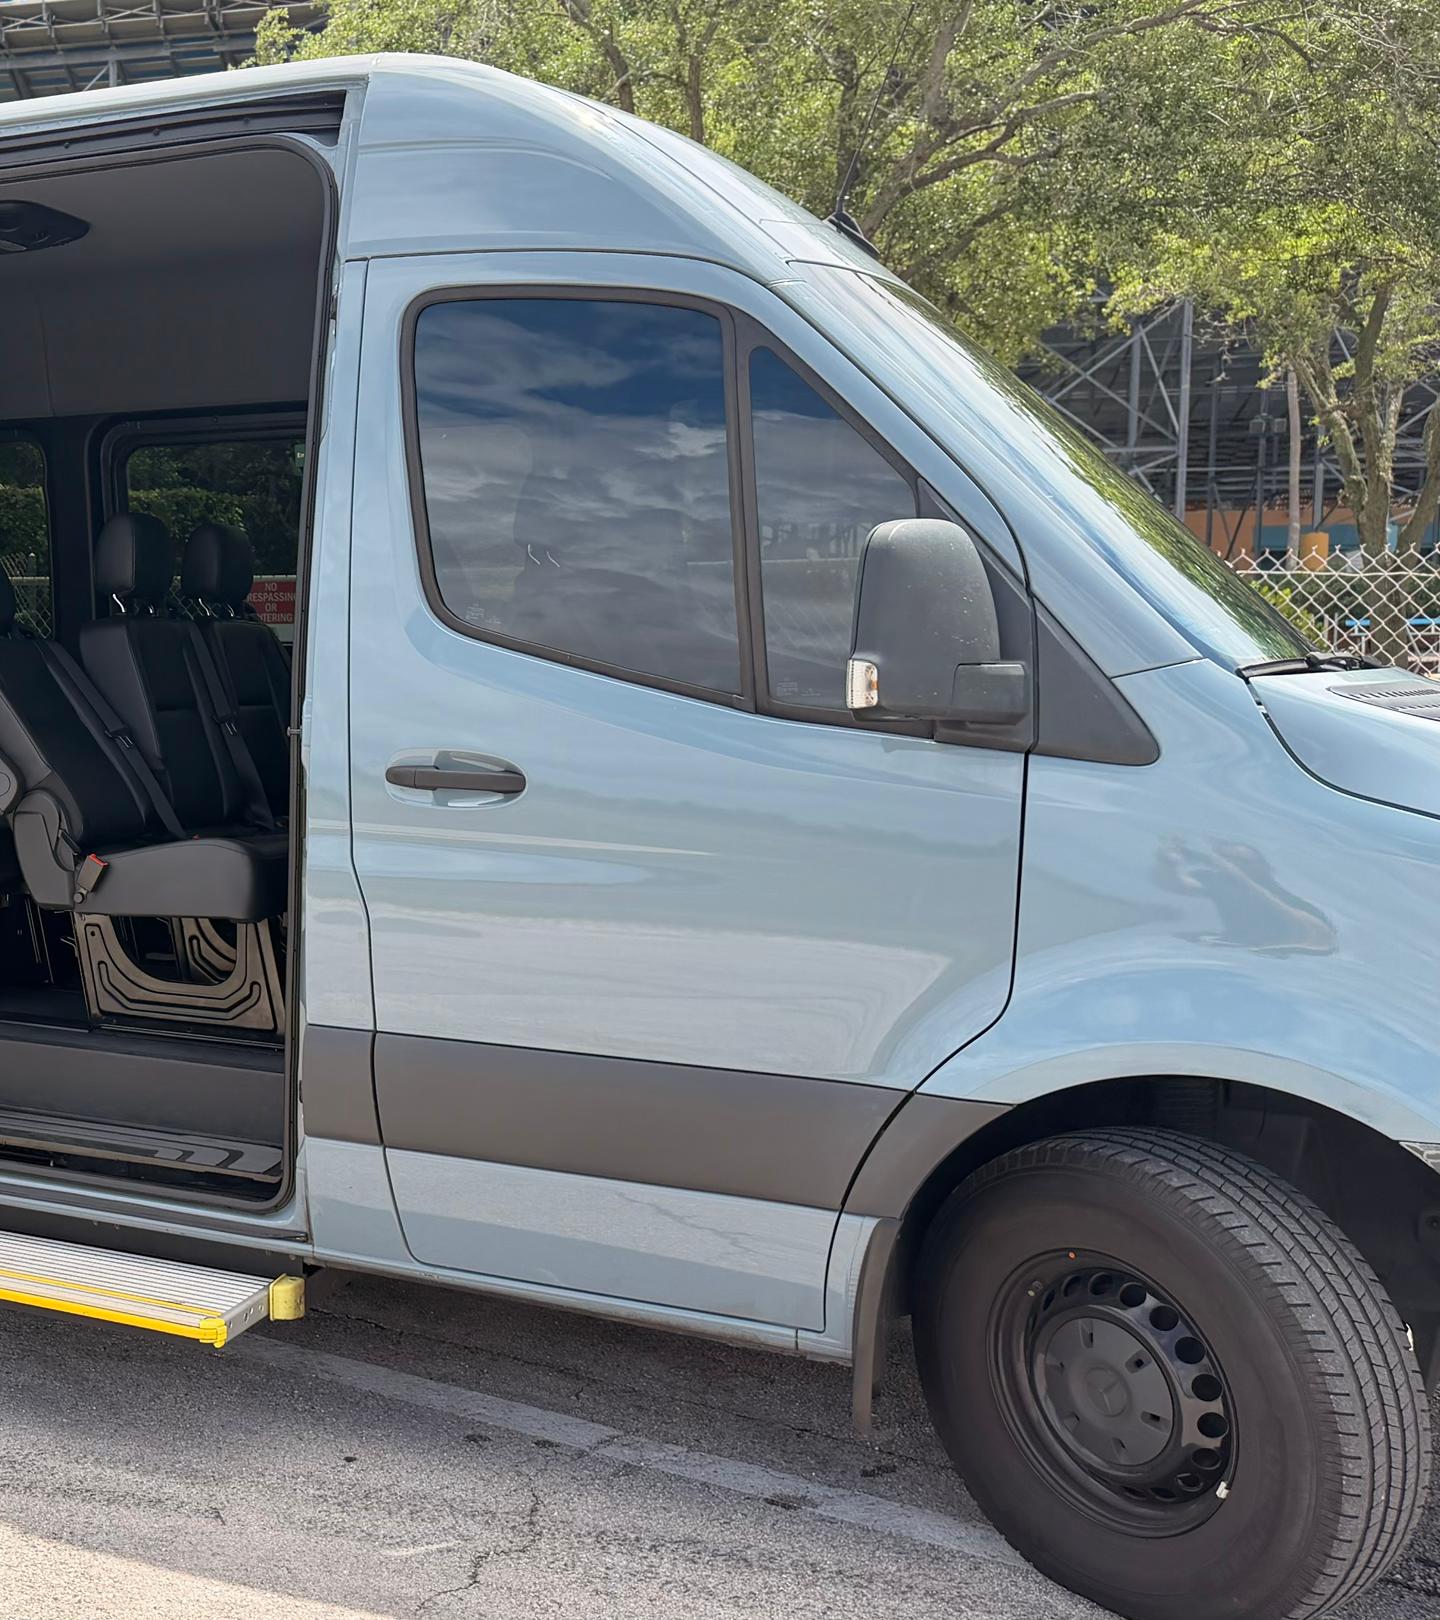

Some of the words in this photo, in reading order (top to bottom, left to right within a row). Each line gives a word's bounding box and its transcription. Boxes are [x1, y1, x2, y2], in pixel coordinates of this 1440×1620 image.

[264, 582, 277, 591] NO
[247, 592, 296, 602] RESPASSIN
[264, 602, 277, 612] OR
[257, 613, 293, 622] TERING
